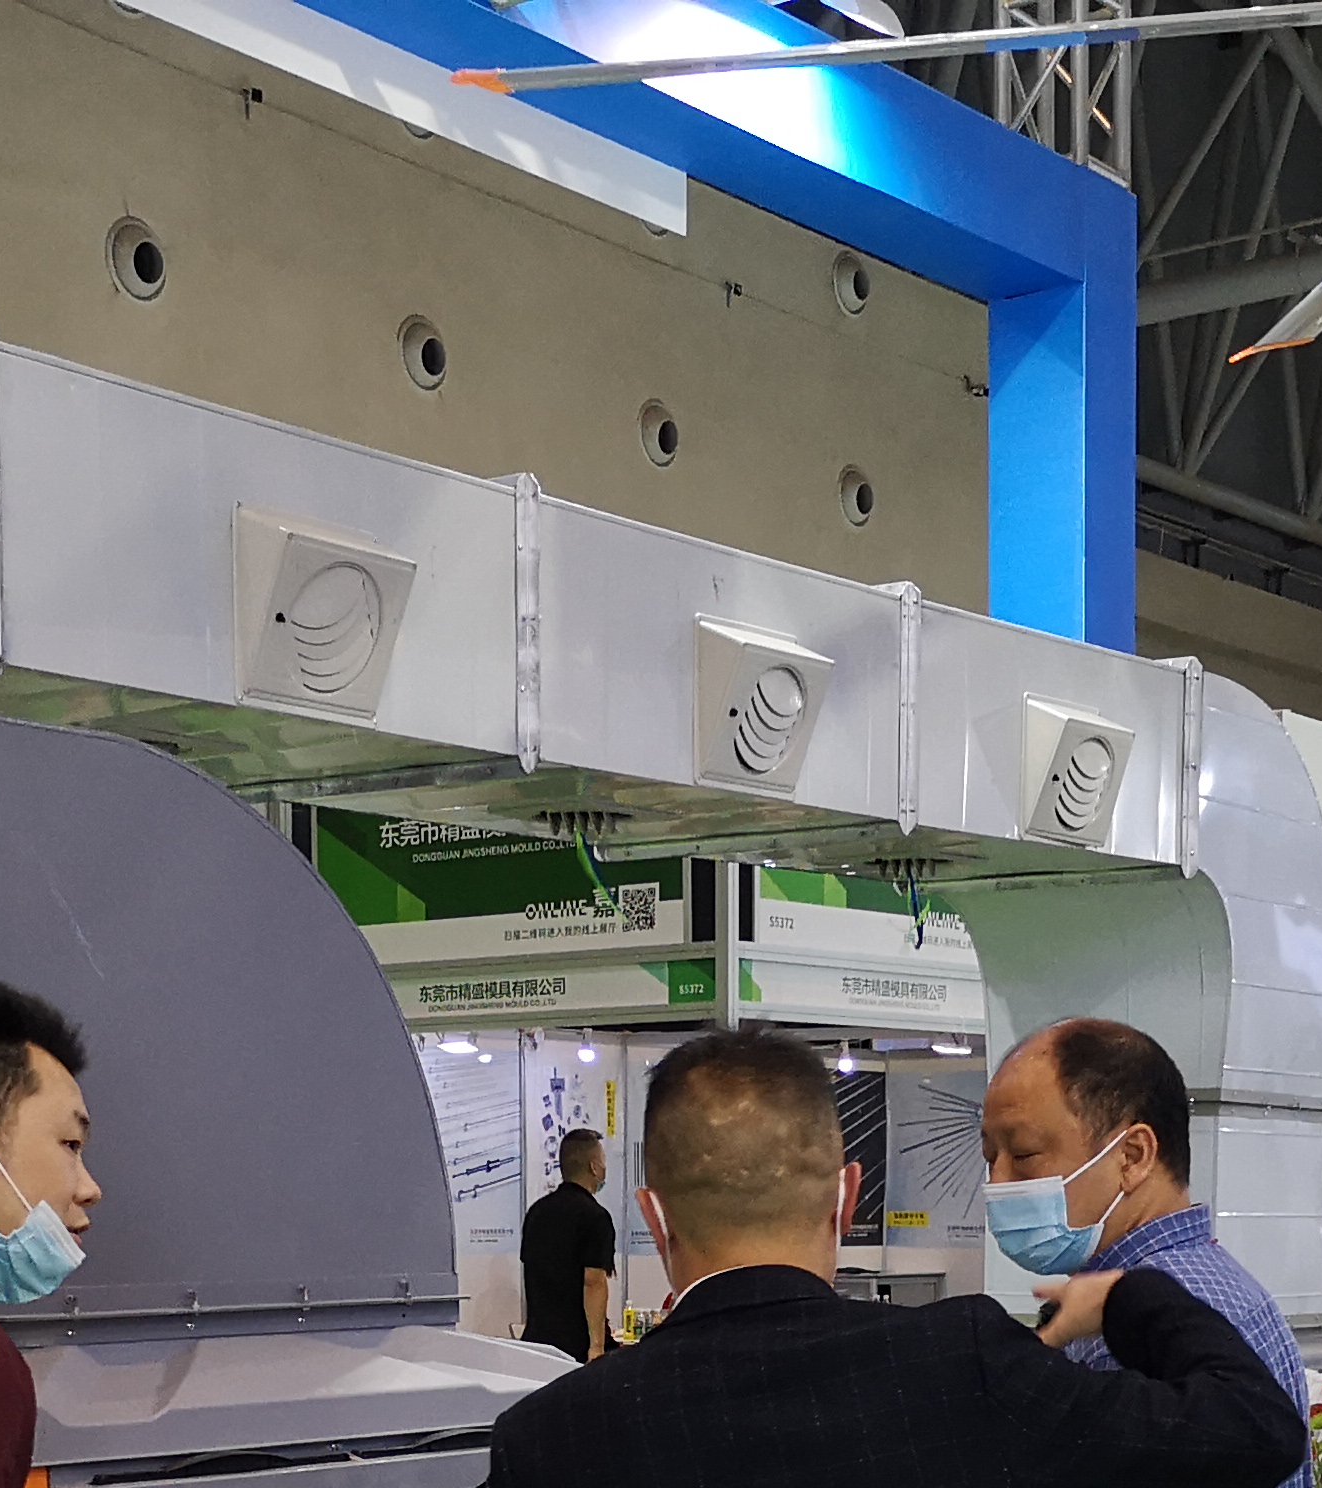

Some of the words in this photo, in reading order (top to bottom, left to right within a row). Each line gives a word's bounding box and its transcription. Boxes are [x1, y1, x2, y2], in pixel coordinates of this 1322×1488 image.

[380, 821, 506, 849] 东莞市精
[526, 901, 587, 920] ONLINE
[769, 915, 794, 930] S5372
[419, 977, 566, 1003] 东莞市精盛模具有限公司
